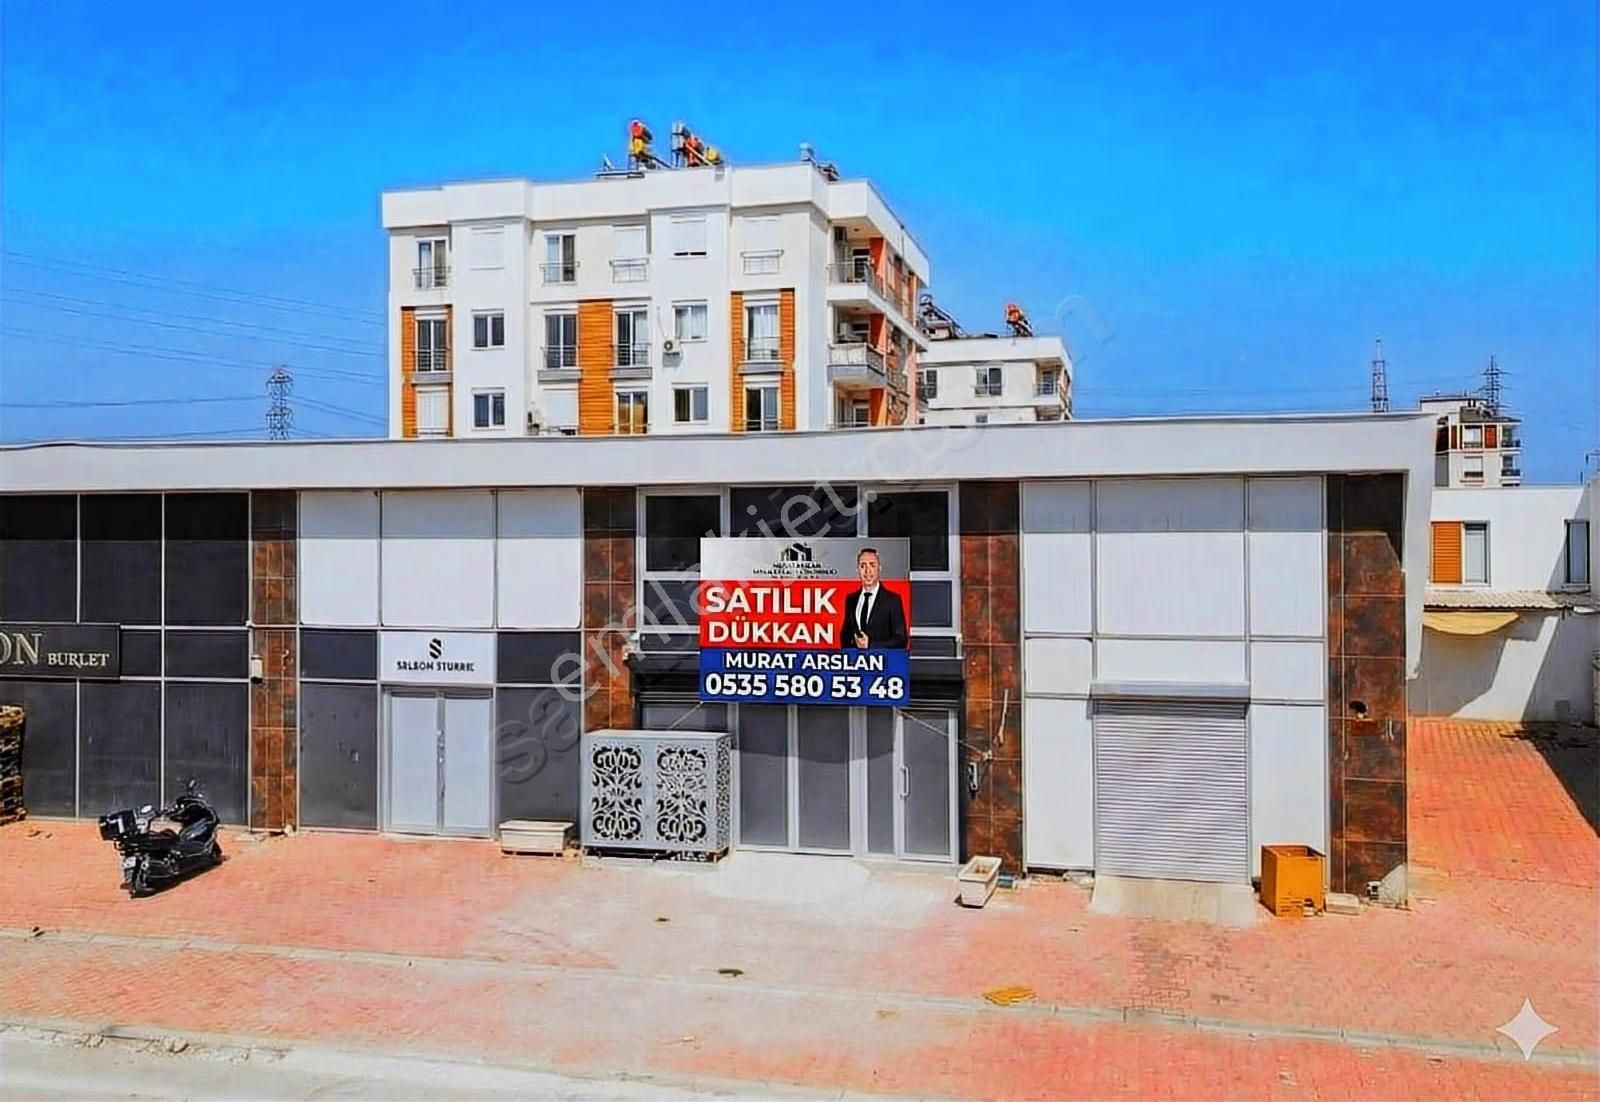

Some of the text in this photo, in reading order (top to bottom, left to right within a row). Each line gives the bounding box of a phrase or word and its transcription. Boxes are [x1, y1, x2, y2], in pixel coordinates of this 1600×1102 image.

[705, 586, 838, 615] SATILIK
[708, 616, 834, 645] DÜKKAN
[47, 652, 110, 668] BURLET
[725, 652, 884, 671] MURAT ARSLAN
[705, 673, 904, 699] 0535 580 53 48
